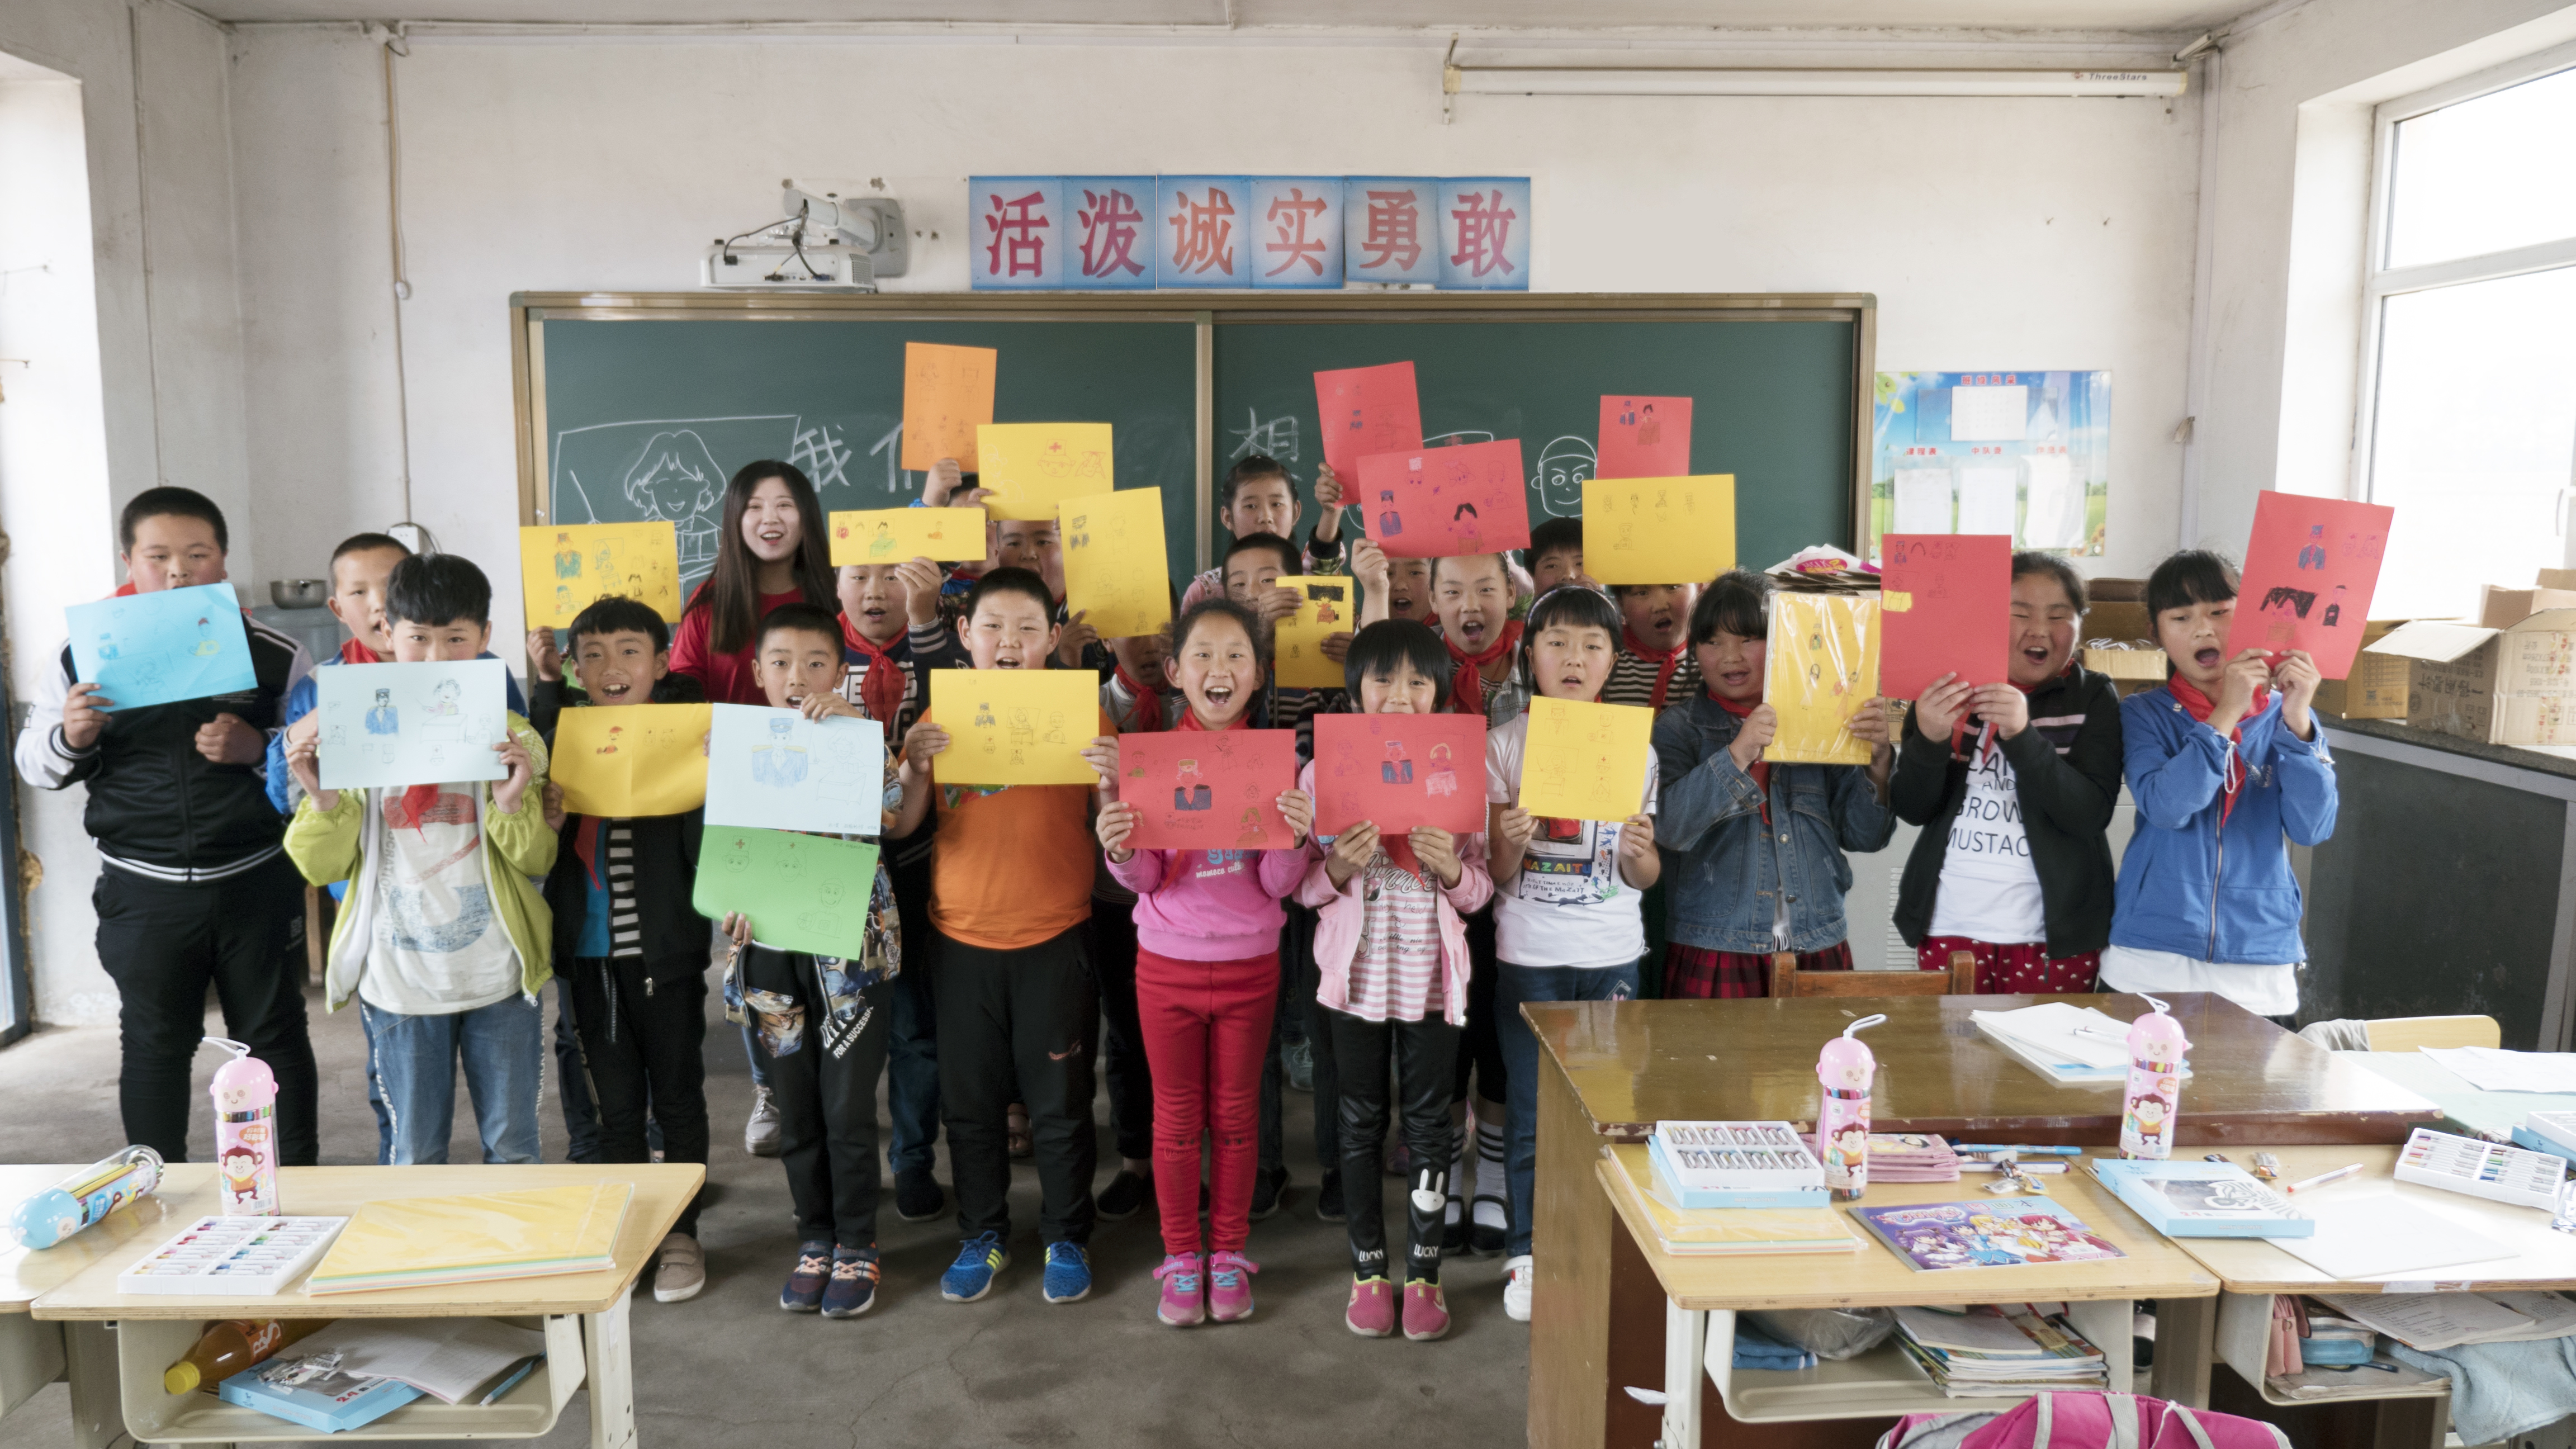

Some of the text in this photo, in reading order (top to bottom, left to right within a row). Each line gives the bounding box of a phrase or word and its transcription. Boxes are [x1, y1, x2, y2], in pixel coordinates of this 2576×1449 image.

[2089, 73, 2148, 81] ThreeStars
[985, 186, 1516, 278] 活泼诚实勇敢
[1906, 447, 1938, 456] 课程表
[1971, 446, 2003, 455] 中队委
[1982, 778, 2016, 791] AND
[1195, 868, 1226, 879] momoco
[833, 1043, 847, 1059] FOR
[842, 1039, 852, 1048] A
[1358, 1248, 1384, 1262] LUCKY
[1413, 1243, 1439, 1258] LUCKY
